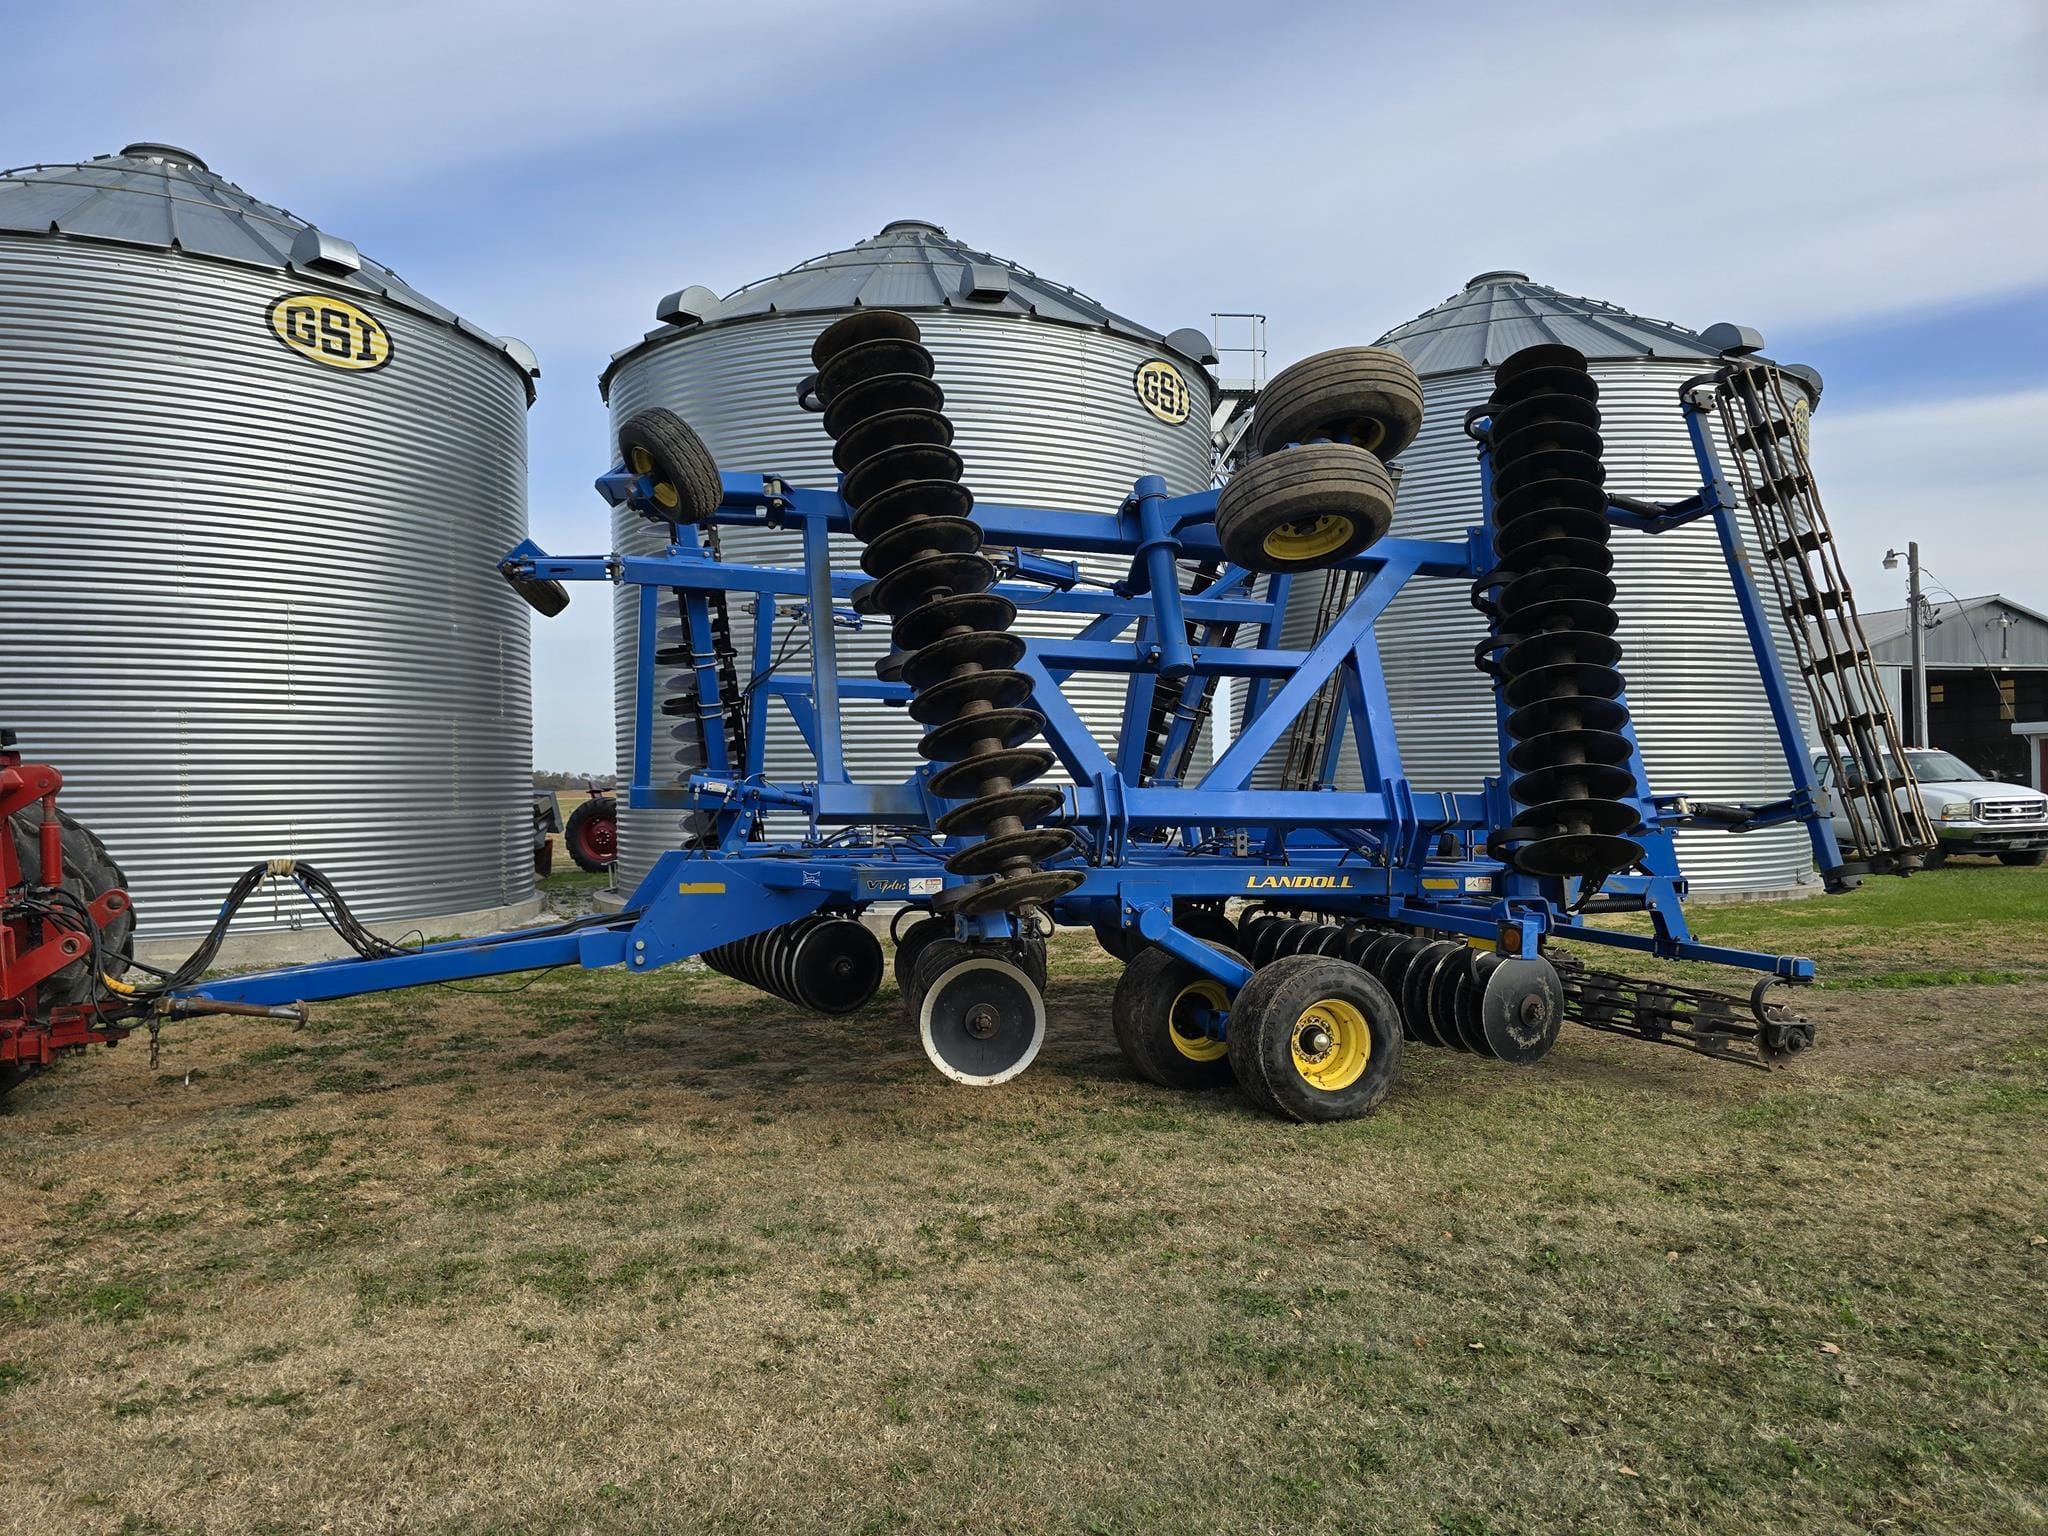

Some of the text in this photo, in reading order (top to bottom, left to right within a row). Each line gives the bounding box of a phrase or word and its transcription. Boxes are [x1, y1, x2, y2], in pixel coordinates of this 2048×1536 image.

[286, 306, 377, 361] GSI
[1144, 370, 1185, 416] GSI
[1246, 876, 1354, 888] LANDOLL
